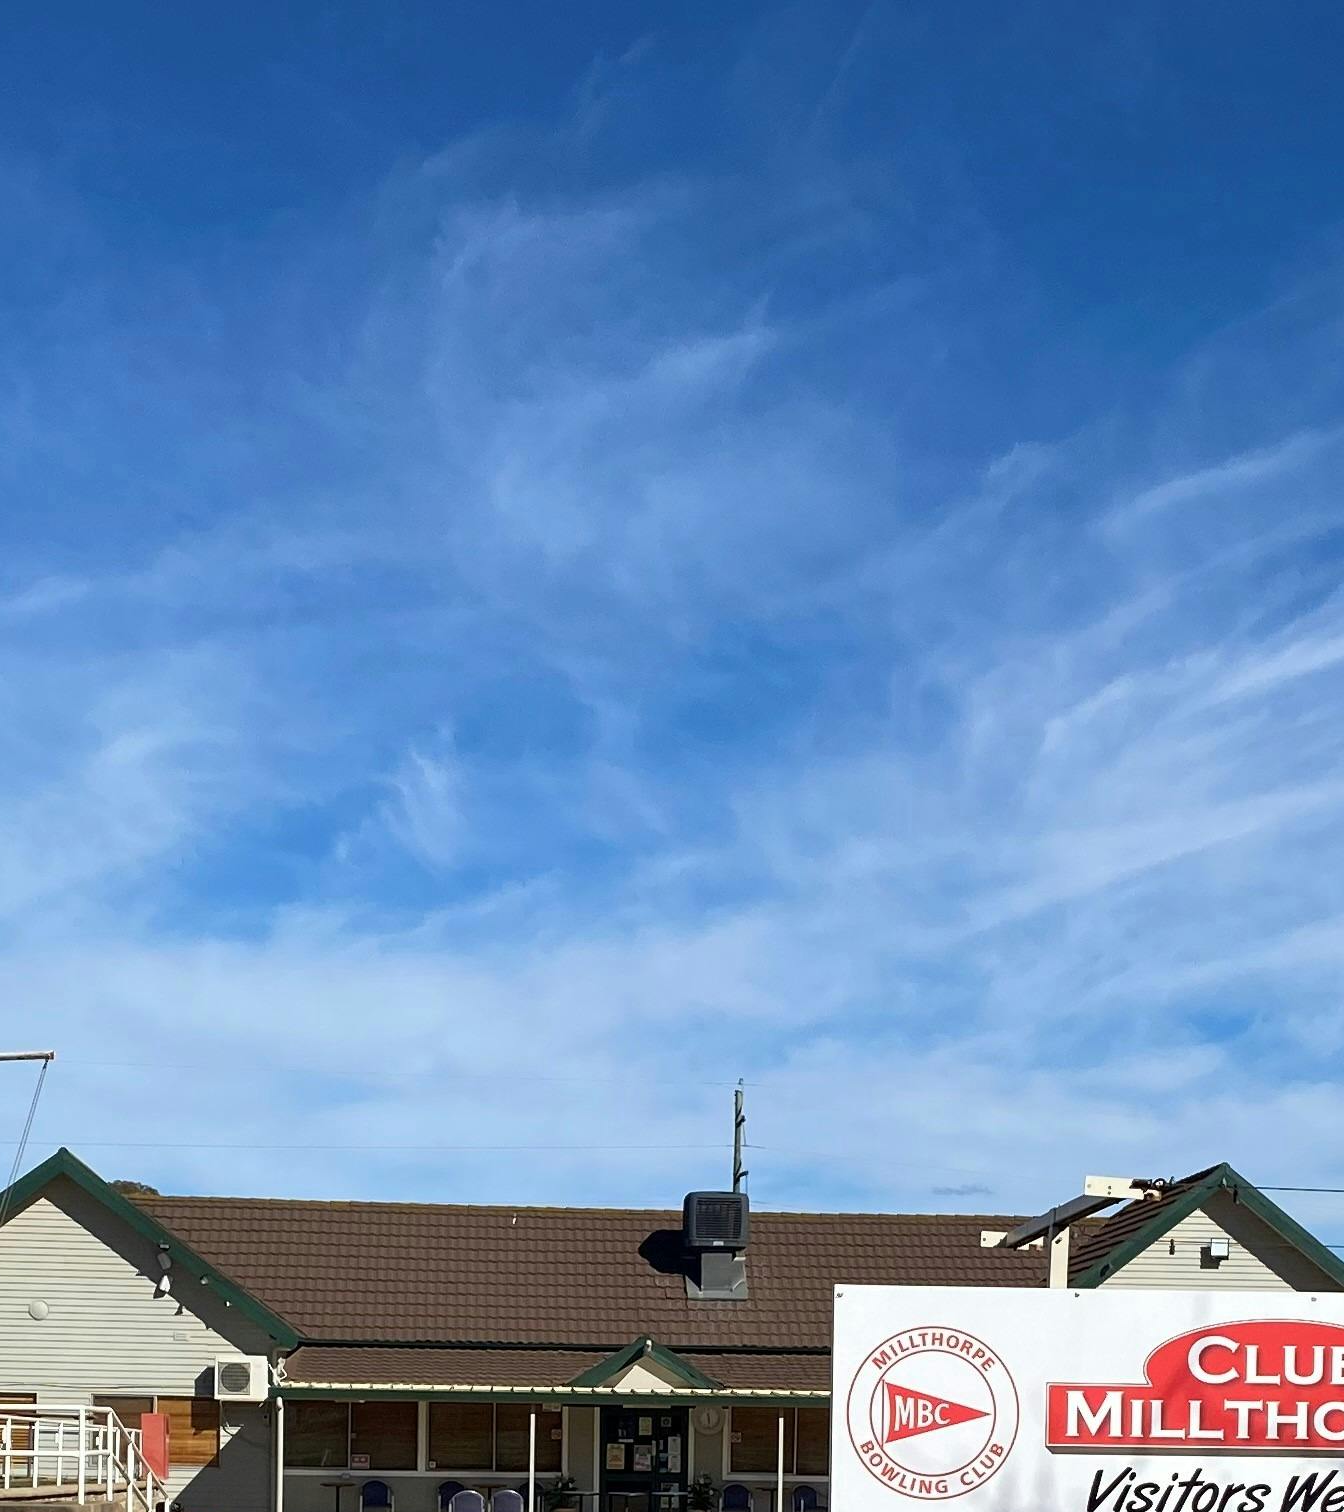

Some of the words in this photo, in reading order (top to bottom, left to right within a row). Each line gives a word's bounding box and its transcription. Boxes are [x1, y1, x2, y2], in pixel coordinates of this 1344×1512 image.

[871, 1332, 995, 1372] MILLTHORPE
[894, 1395, 951, 1432] MBC
[860, 1440, 949, 1494] BOWLING
[960, 1443, 1004, 1487] CLUB
